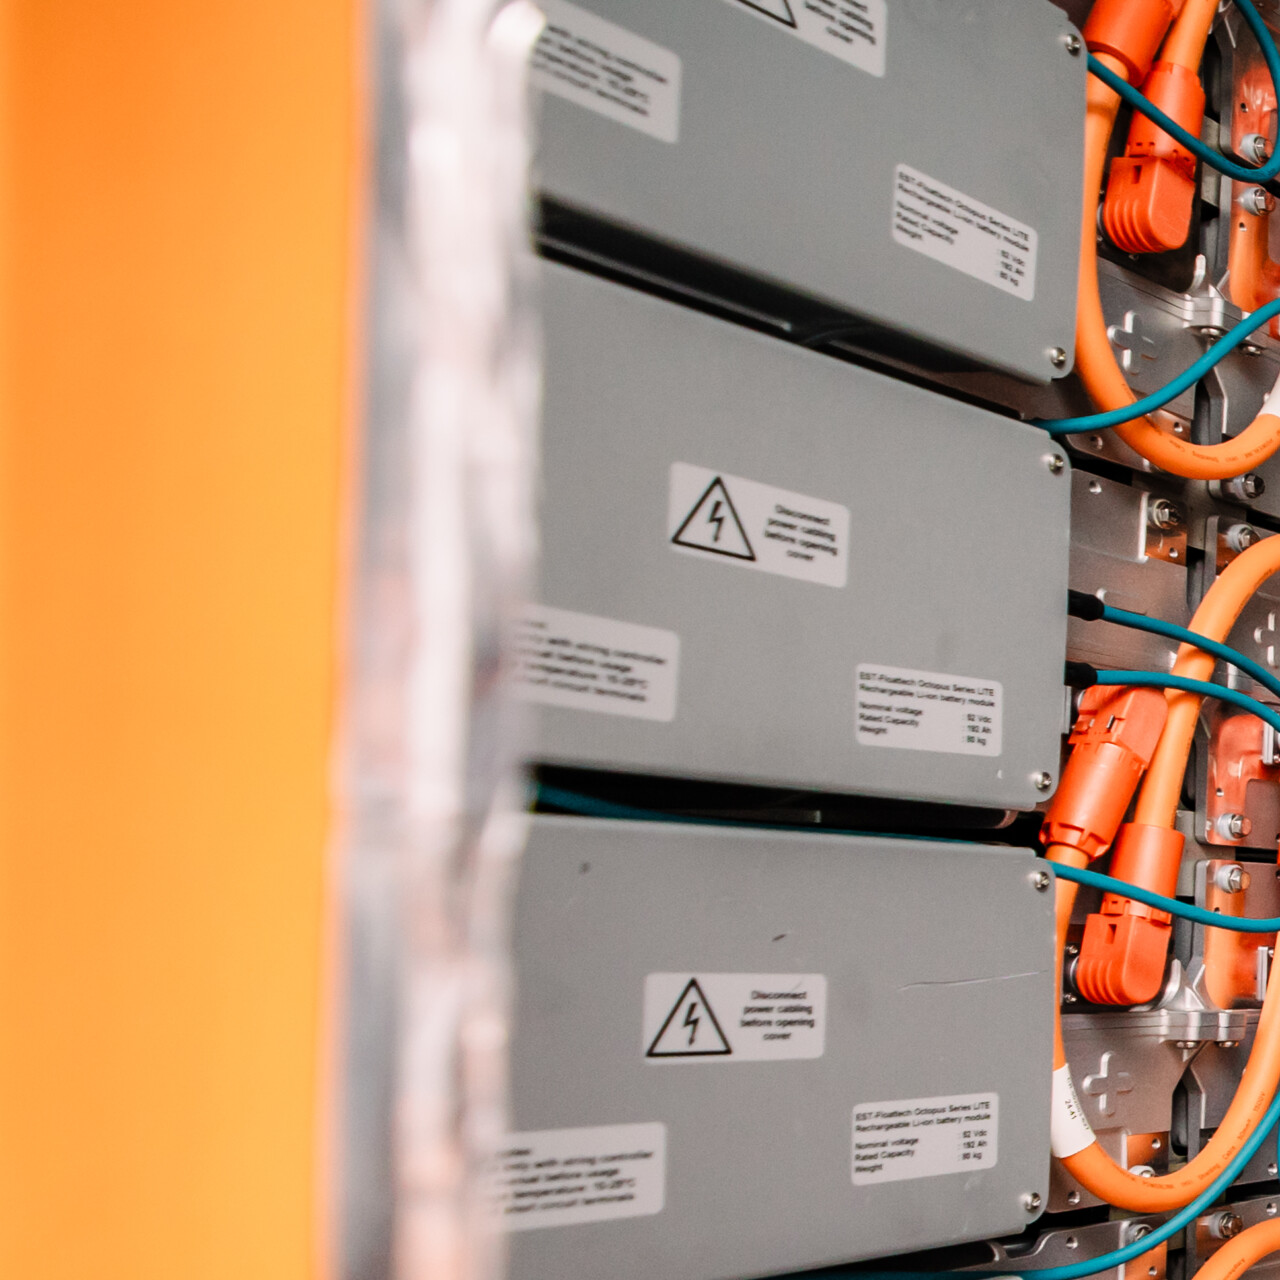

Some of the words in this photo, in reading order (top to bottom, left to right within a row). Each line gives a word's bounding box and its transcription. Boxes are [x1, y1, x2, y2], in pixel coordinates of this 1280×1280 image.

[775, 503, 830, 527] Disconnect
[767, 517, 798, 534] power
[800, 524, 836, 543] cabling
[764, 529, 796, 546] before
[798, 538, 838, 557] opening
[786, 548, 815, 563] cover
[750, 990, 807, 1000] Disconnect
[743, 1005, 774, 1015] power
[776, 1003, 813, 1015] cabling
[740, 1018, 773, 1028] before
[775, 1018, 815, 1028] opening
[763, 1031, 792, 1040] cover
[948, 1103, 971, 1113] Series
[936, 1115, 962, 1126] battery
[964, 1112, 991, 1122] module
[890, 1136, 918, 1148] voltage
